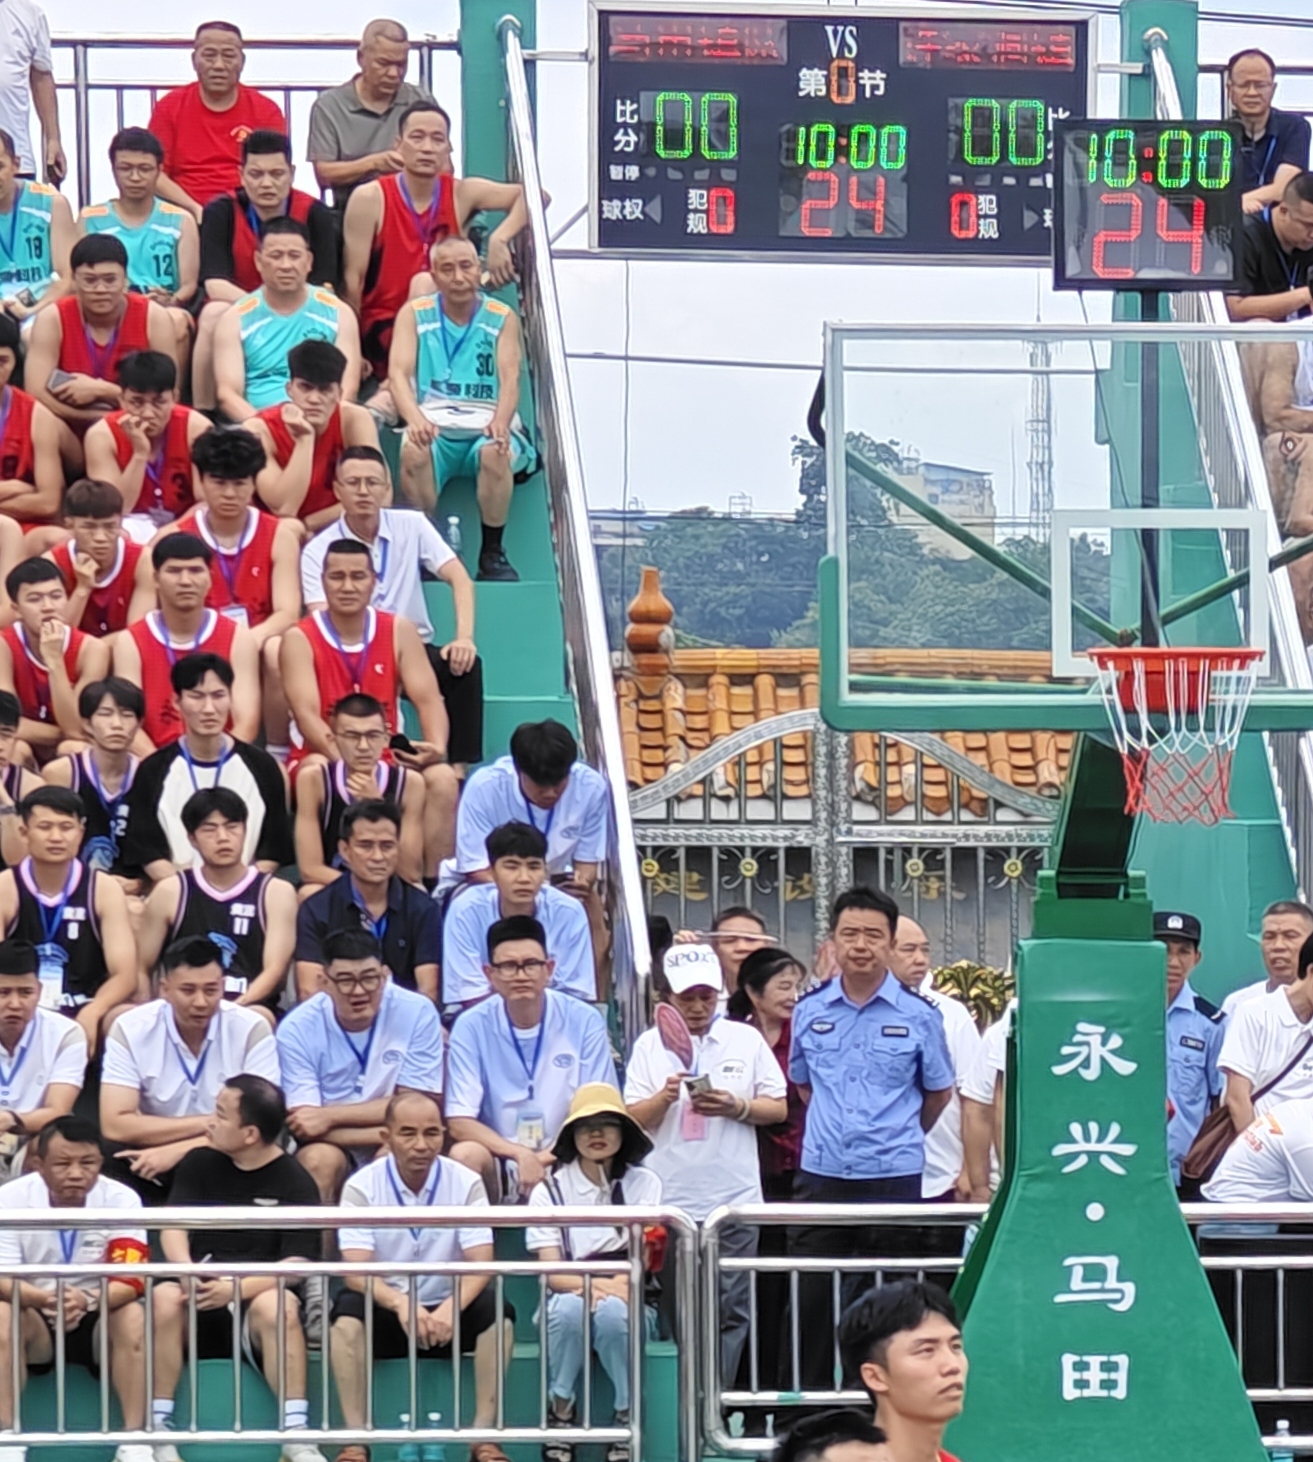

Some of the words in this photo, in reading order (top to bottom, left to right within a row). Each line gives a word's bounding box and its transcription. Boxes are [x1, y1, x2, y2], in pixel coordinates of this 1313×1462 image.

[824, 25, 858, 58] VS
[613, 99, 639, 152] 比分
[656, 92, 738, 159] 00
[797, 124, 906, 169] 10:00
[963, 98, 1045, 166] 00
[1087, 129, 1232, 188] 10:00
[602, 199, 644, 220] 球权
[686, 189, 708, 234] 犯规
[709, 187, 735, 234] 0
[801, 171, 885, 236] 24
[950, 193, 977, 239] 0
[977, 195, 999, 240] 犯规
[1092, 192, 1205, 278] 24
